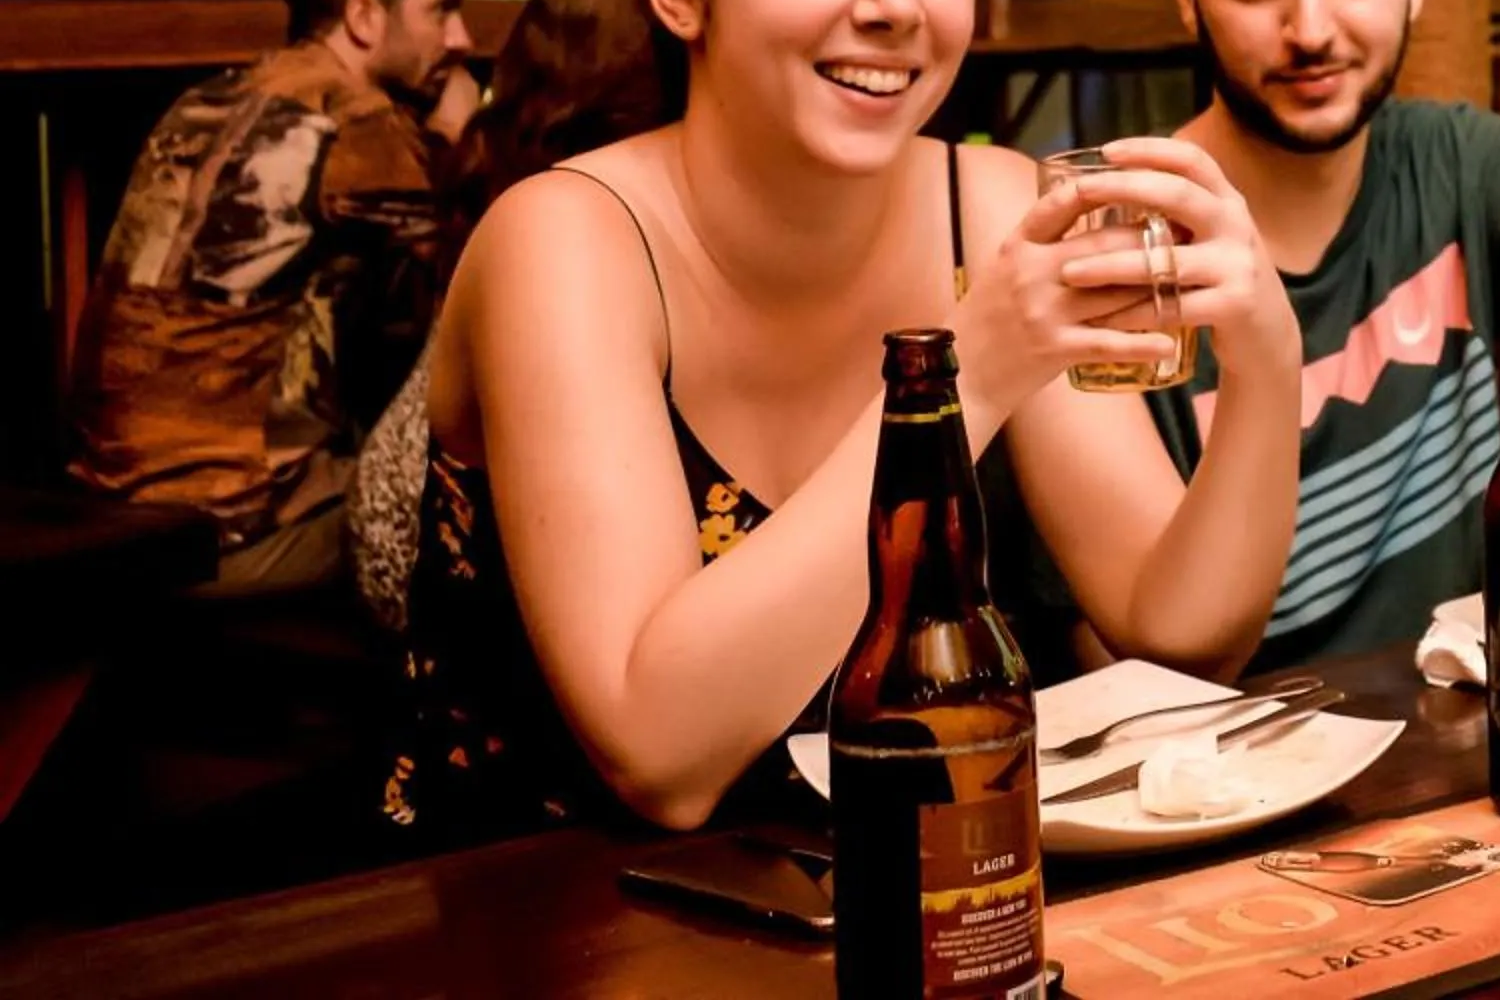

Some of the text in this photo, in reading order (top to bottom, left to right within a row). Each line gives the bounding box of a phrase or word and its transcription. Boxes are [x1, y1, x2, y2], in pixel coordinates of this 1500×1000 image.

[973, 853, 1015, 876] LAGER
[1065, 892, 1341, 987] LIO
[1281, 924, 1462, 981] LAGER
